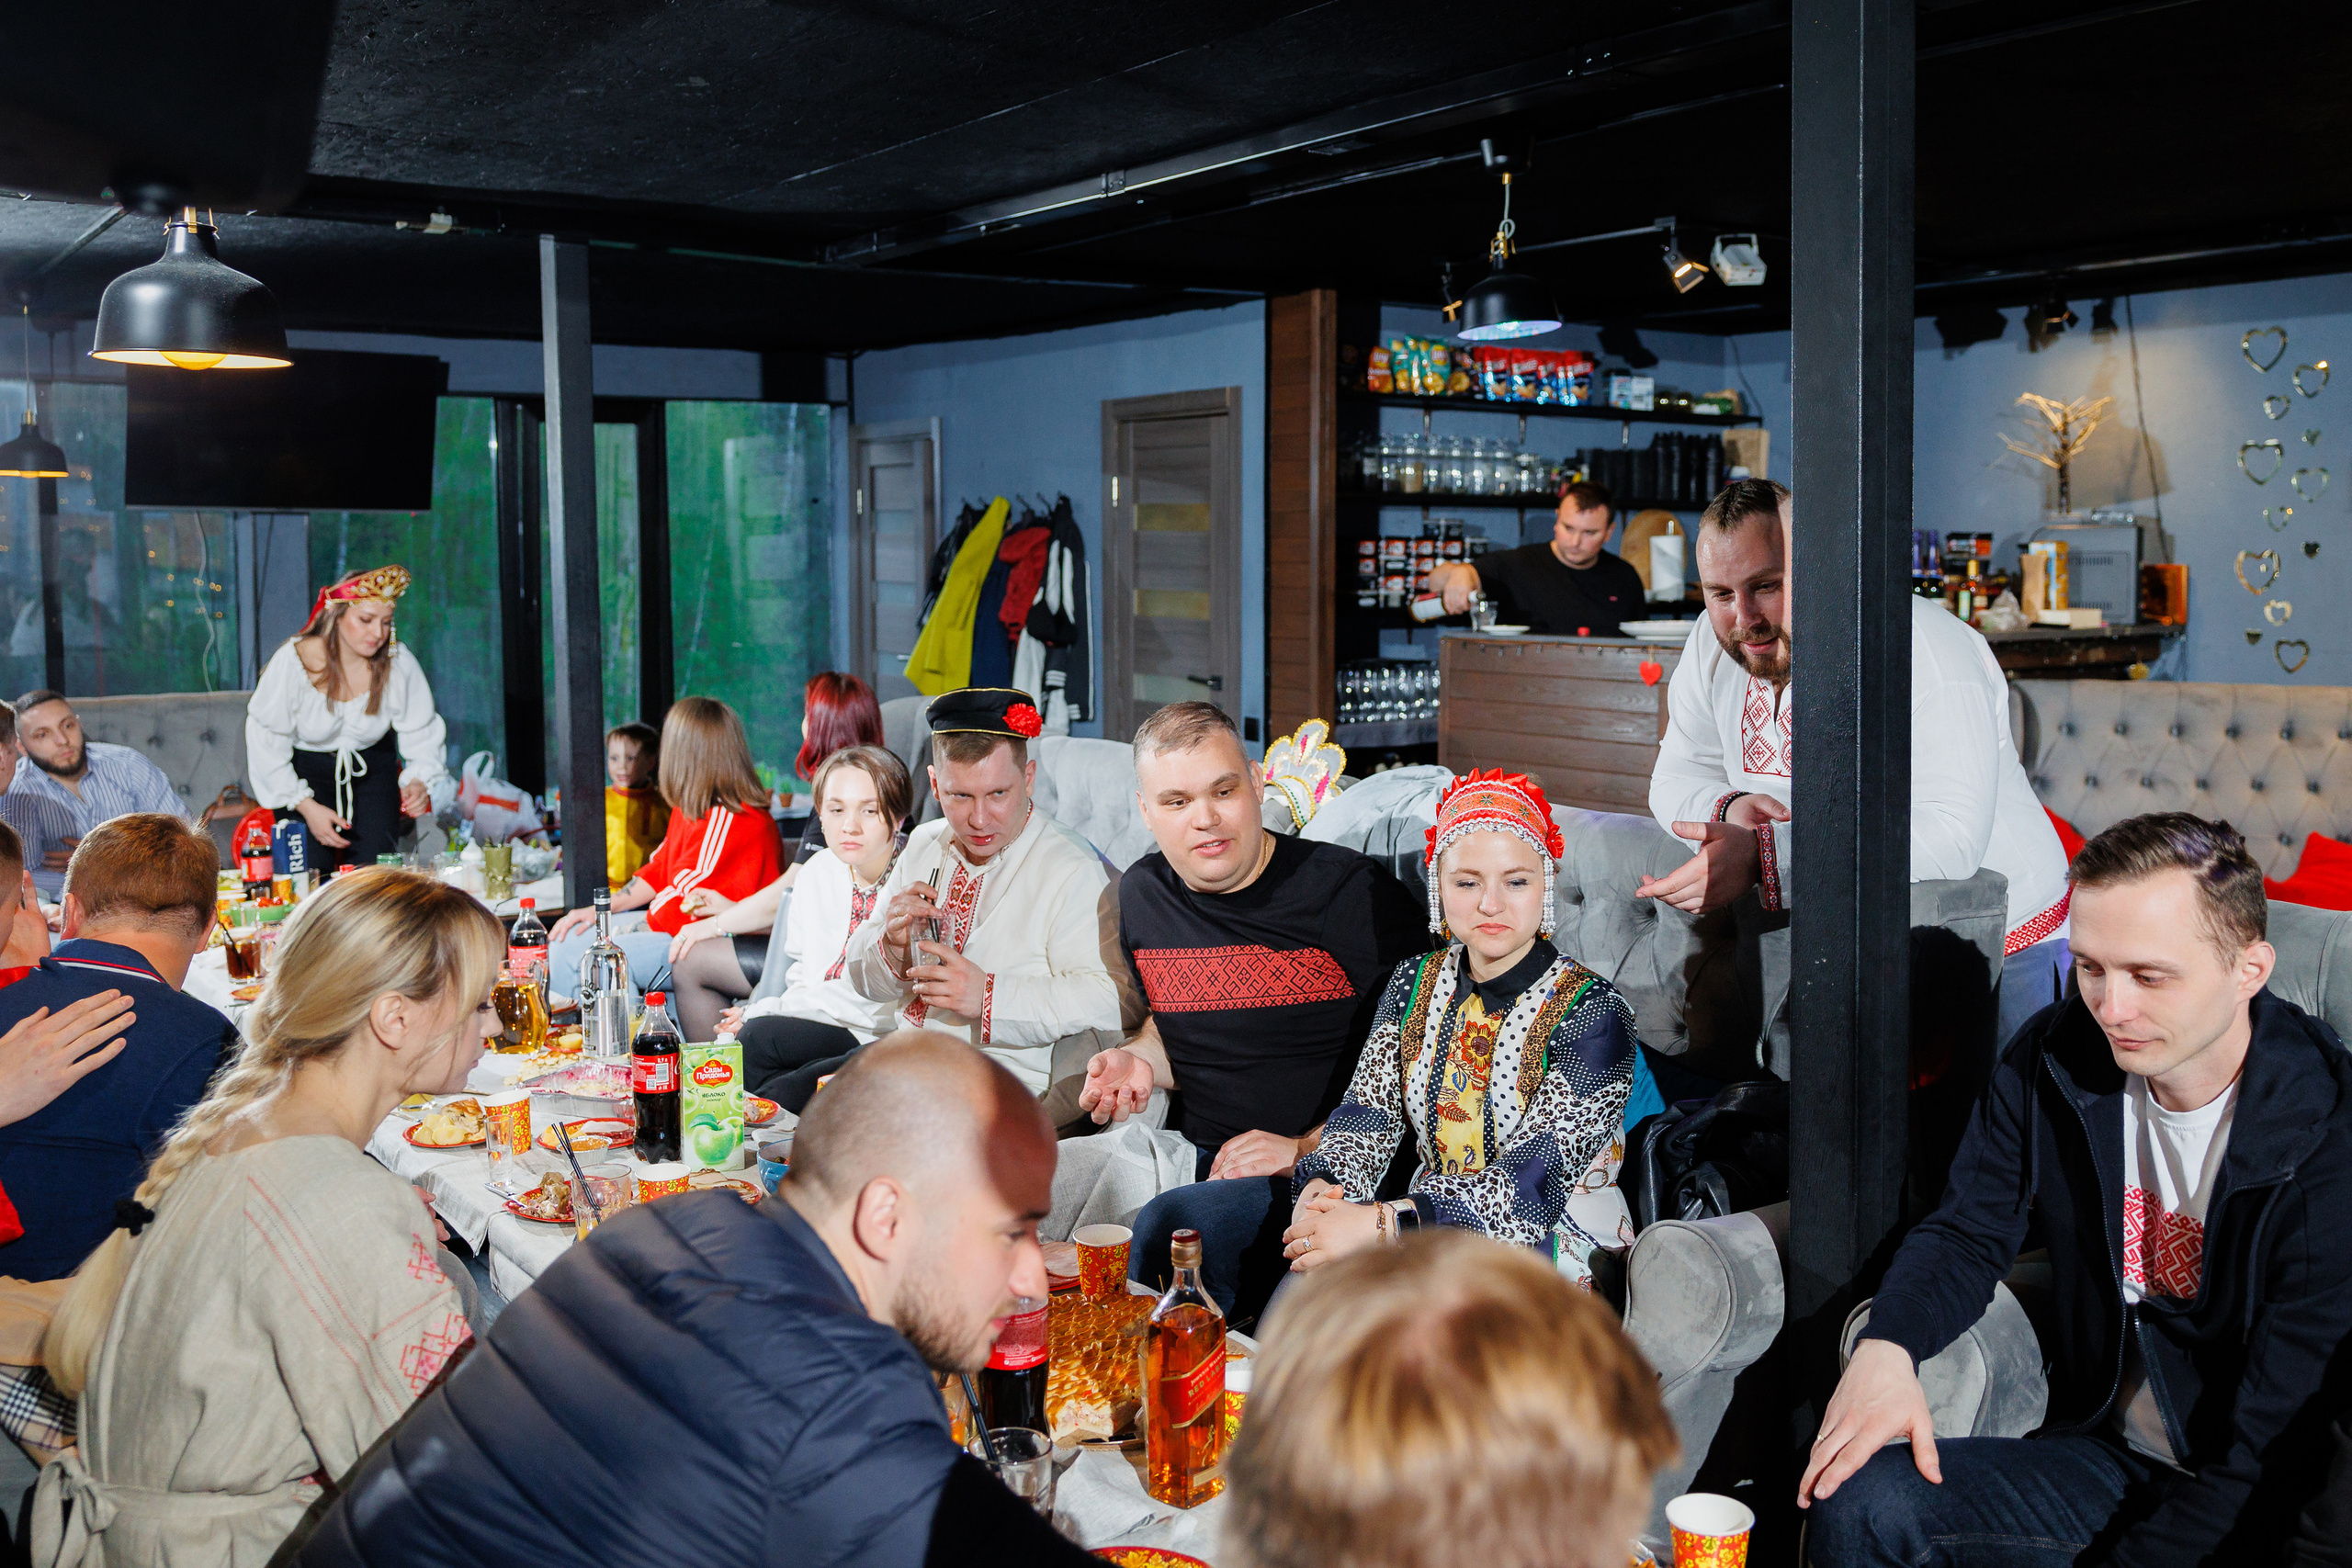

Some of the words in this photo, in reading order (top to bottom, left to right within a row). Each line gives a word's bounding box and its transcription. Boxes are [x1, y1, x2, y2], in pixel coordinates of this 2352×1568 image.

[288, 833, 304, 873] Rich
[696, 1072, 730, 1081] Придонья
[703, 1066, 723, 1074] Сады
[1188, 1380, 1205, 1397] RED
